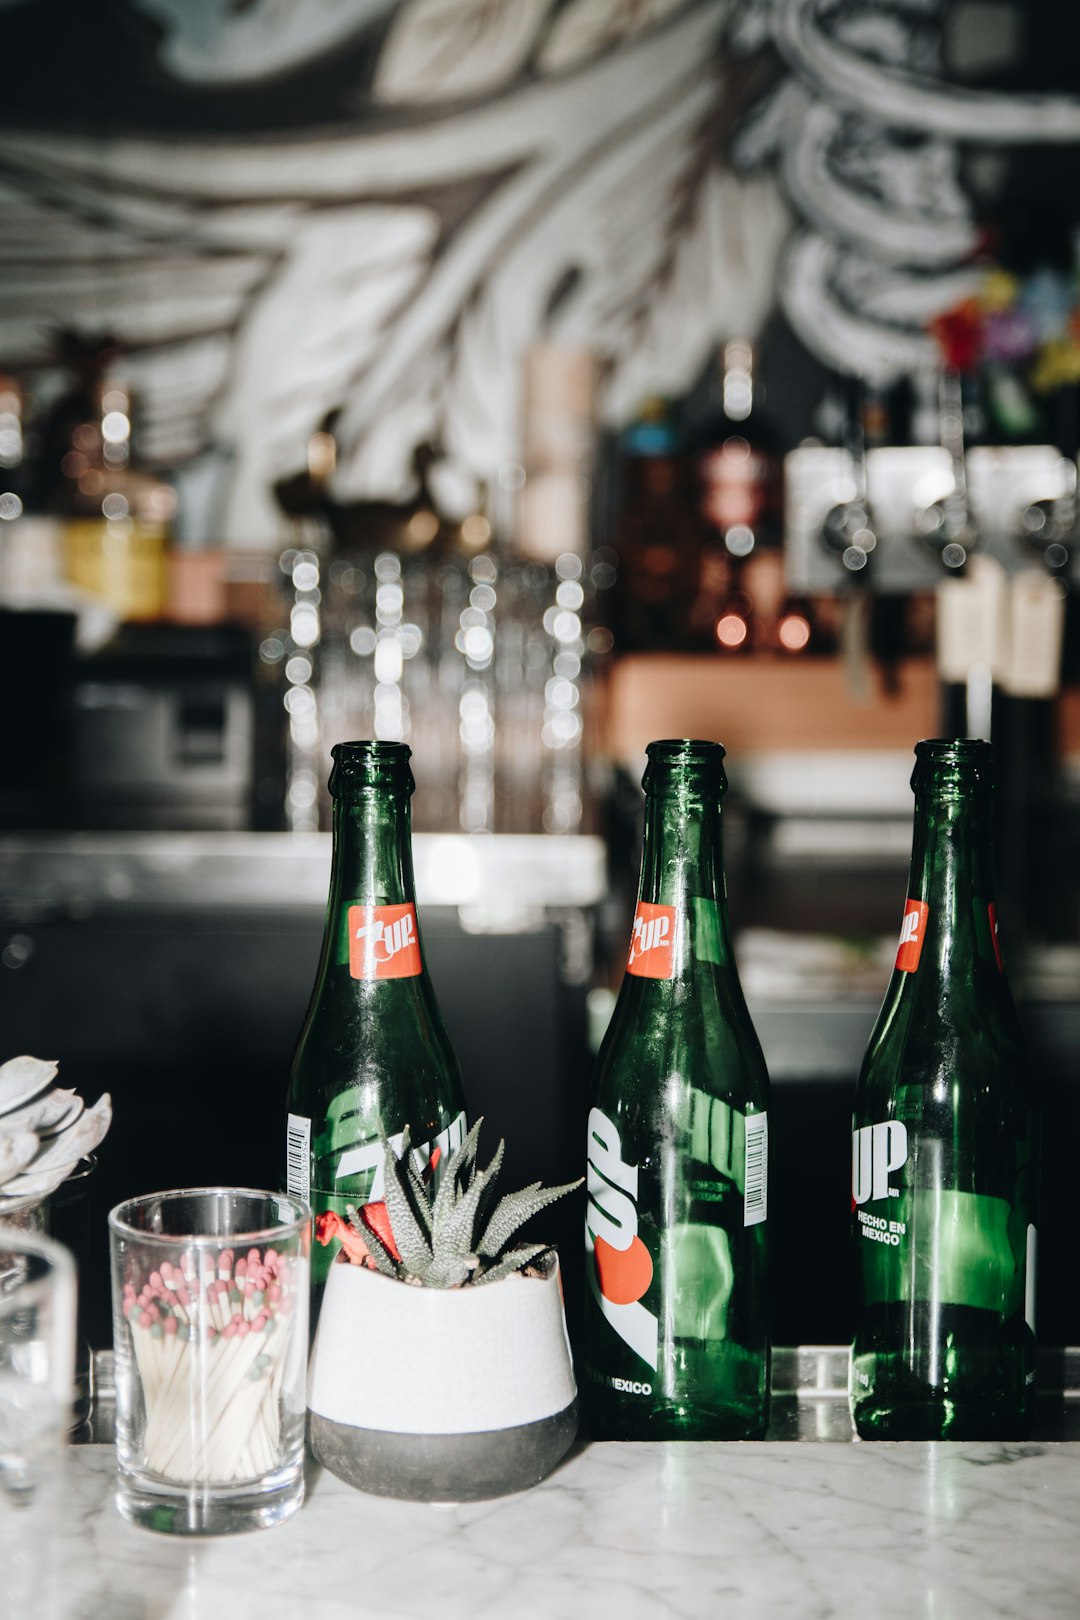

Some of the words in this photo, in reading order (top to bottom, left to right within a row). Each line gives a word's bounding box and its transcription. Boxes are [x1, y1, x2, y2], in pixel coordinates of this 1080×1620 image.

[355, 913, 414, 972] 7UP
[888, 1187, 900, 1197] MR
[857, 1210, 888, 1229] HECHO
[889, 1221, 906, 1234] EN
[862, 1225, 900, 1246] MEXICO
